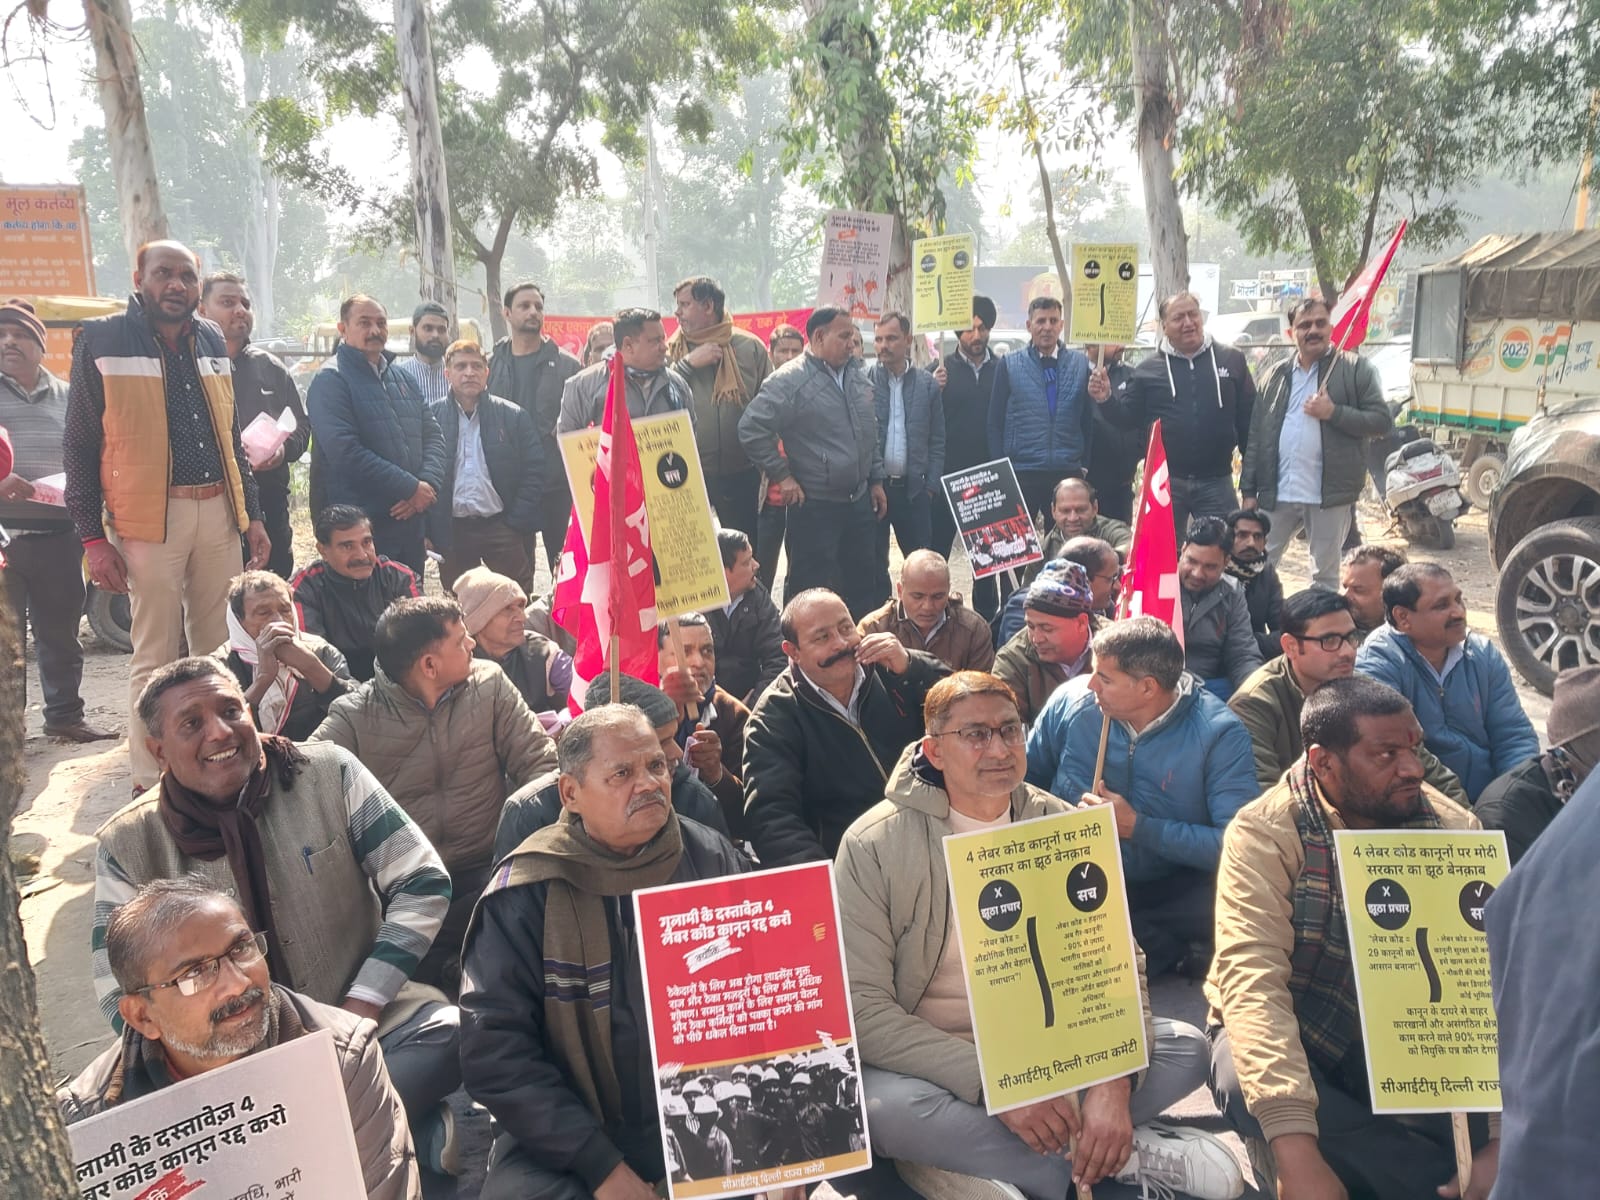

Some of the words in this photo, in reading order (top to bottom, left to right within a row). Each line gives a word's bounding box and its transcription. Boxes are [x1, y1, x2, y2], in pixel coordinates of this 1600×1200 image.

[5, 197, 30, 216] मूल
[1502, 342, 1529, 356] 2025
[966, 851, 974, 863] 4
[977, 847, 1001, 863] लेबर
[1004, 840, 1026, 855] कोड
[1028, 830, 1061, 852] कानूनों
[1064, 831, 1077, 842] पर
[1080, 822, 1102, 839] मोदी
[1353, 845, 1362, 858] 4
[1365, 843, 1391, 859] लेबर
[1393, 843, 1417, 858] कोड
[1420, 843, 1454, 863] कानूनों
[1457, 847, 1472, 859] पर
[1474, 843, 1498, 859] मोदी
[979, 864, 1015, 879] सरकार
[1017, 860, 1032, 872] का
[1034, 855, 1053, 871] झूठ
[1366, 864, 1404, 876] सरकार
[1407, 864, 1422, 876] का
[1424, 864, 1444, 879] झूठ
[1077, 886, 1098, 902] सच
[701, 906, 714, 923] के
[764, 899, 774, 912] 4
[980, 905, 999, 921] झूठा
[1001, 901, 1021, 914] प्रचार
[1367, 903, 1387, 917] झूठा
[1388, 903, 1410, 914] प्रचार
[1470, 907, 1485, 920] स
[768, 910, 792, 927] करो
[1381, 947, 1404, 960] कानूनों
[1406, 947, 1416, 957] को
[1000, 960, 1013, 971] और
[1369, 962, 1393, 971] आसान
[1406, 1007, 1428, 1019] कानून
[1431, 1005, 1438, 1016] के
[1440, 1005, 1458, 1016] दायरे
[1460, 1005, 1468, 1016] से
[1469, 1007, 1488, 1017] बाहर
[1393, 1018, 1427, 1029] कारखानों
[1429, 1018, 1444, 1029] और
[1446, 1018, 1481, 1029] असंगठित
[1399, 1033, 1416, 1043] काम
[1417, 1031, 1435, 1043] करने
[1437, 1031, 1453, 1042] वाले
[1454, 1031, 1474, 1042] 90%
[1407, 1044, 1419, 1056] को
[1420, 1044, 1446, 1058] नियुक्ति
[1448, 1046, 1461, 1056] पत्र
[1462, 1044, 1479, 1055] कौन
[997, 1065, 1053, 1091] सीआईटीयू
[1053, 1054, 1083, 1076] दिल्ली
[1084, 1049, 1109, 1066] राज्य
[1111, 1037, 1138, 1059] कमेटी
[1380, 1077, 1440, 1097] सीआईटीयू
[1440, 1076, 1474, 1093] दिल्ली
[76, 1142, 127, 1183] लामी
[129, 1134, 152, 1157] के
[153, 1101, 235, 1148] दस्तावेज़
[240, 1095, 255, 1112] 4
[81, 1180, 111, 1200] बर
[112, 1160, 158, 1191] कोड
[159, 1134, 217, 1171] कानून
[218, 1123, 247, 1145] रद्द
[247, 1103, 288, 1134] करो
[274, 1167, 303, 1190] भारी
